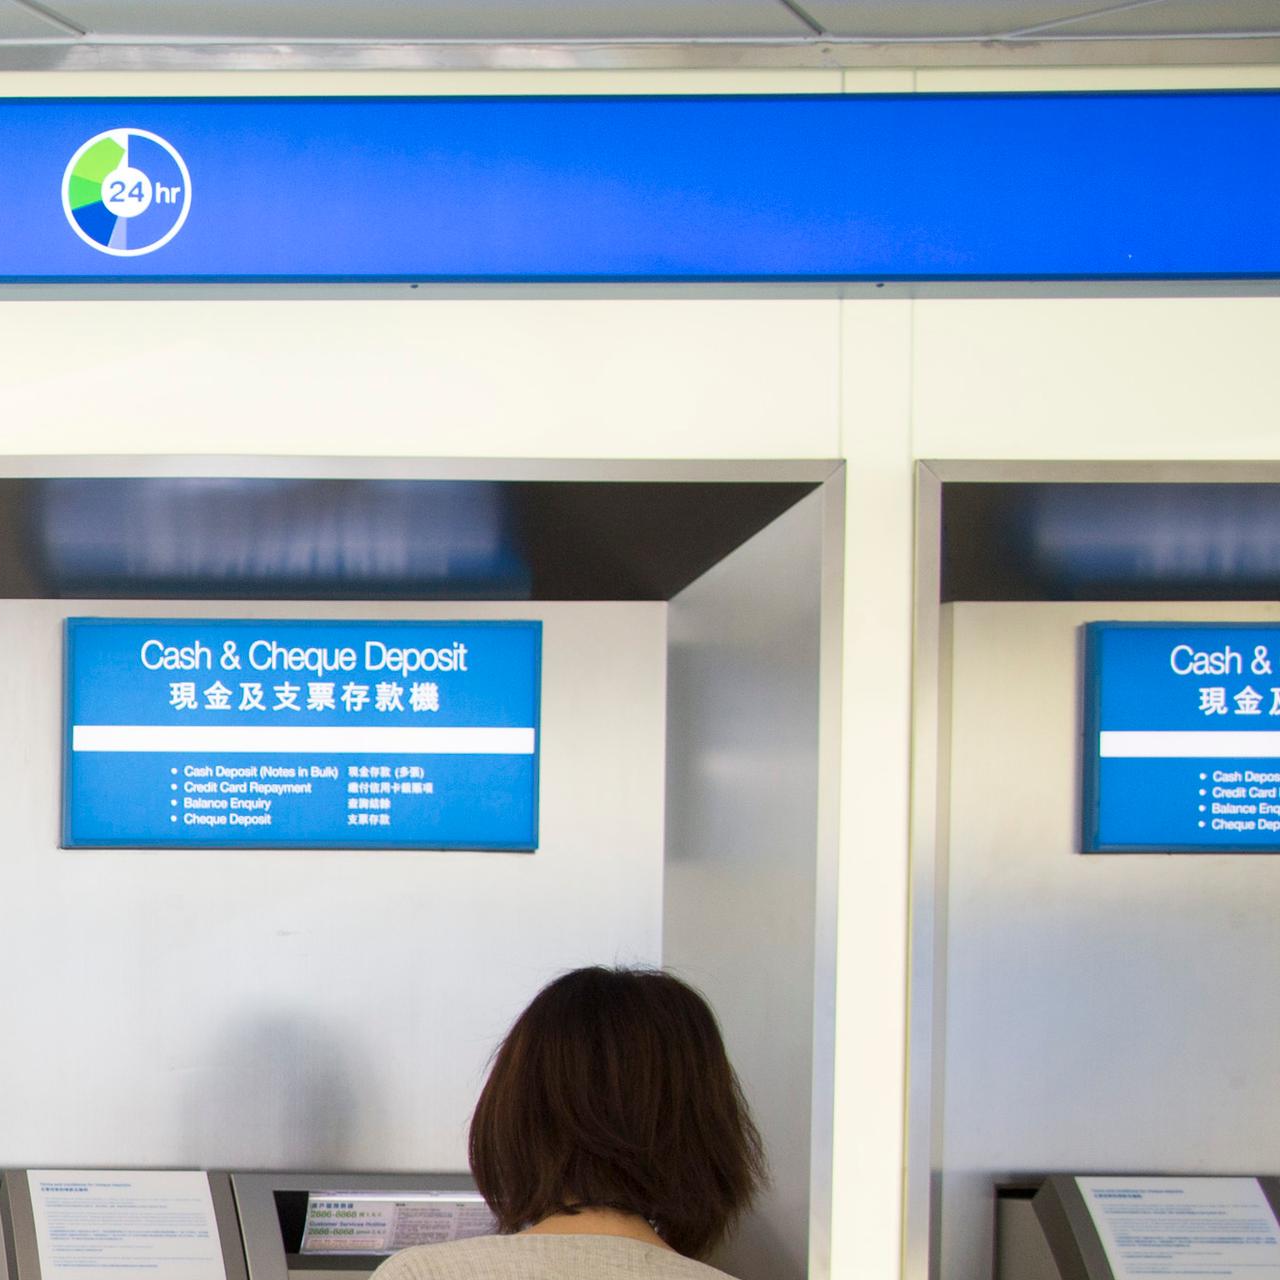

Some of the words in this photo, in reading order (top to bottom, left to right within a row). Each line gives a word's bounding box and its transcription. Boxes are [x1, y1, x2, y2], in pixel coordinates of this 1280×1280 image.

[109, 181, 145, 203] 24
[155, 182, 181, 204] hr
[140, 639, 212, 671] Cash
[221, 642, 241, 671] &
[248, 640, 357, 677] Cheque
[365, 642, 468, 678] Deposit
[1170, 645, 1242, 675] Cash
[1251, 645, 1273, 675] &
[170, 681, 440, 713] 現金及支票存款機
[183, 766, 213, 778] Cash
[215, 766, 257, 780] Deposit
[259, 766, 295, 780] (Notes
[297, 766, 308, 778] in
[310, 766, 339, 780] Bulk)
[1212, 771, 1242, 783] Cash
[183, 783, 217, 794] Credit
[220, 783, 247, 794] Card
[249, 783, 312, 797] Repayment
[1212, 787, 1246, 798] Credit
[1249, 787, 1277, 798] Card
[183, 798, 227, 809] Balance
[229, 798, 271, 812] Enquiry
[1212, 803, 1257, 814] Balance
[183, 814, 227, 828] Cheque
[229, 814, 272, 828] Deposit
[1212, 819, 1256, 832] Cheque
